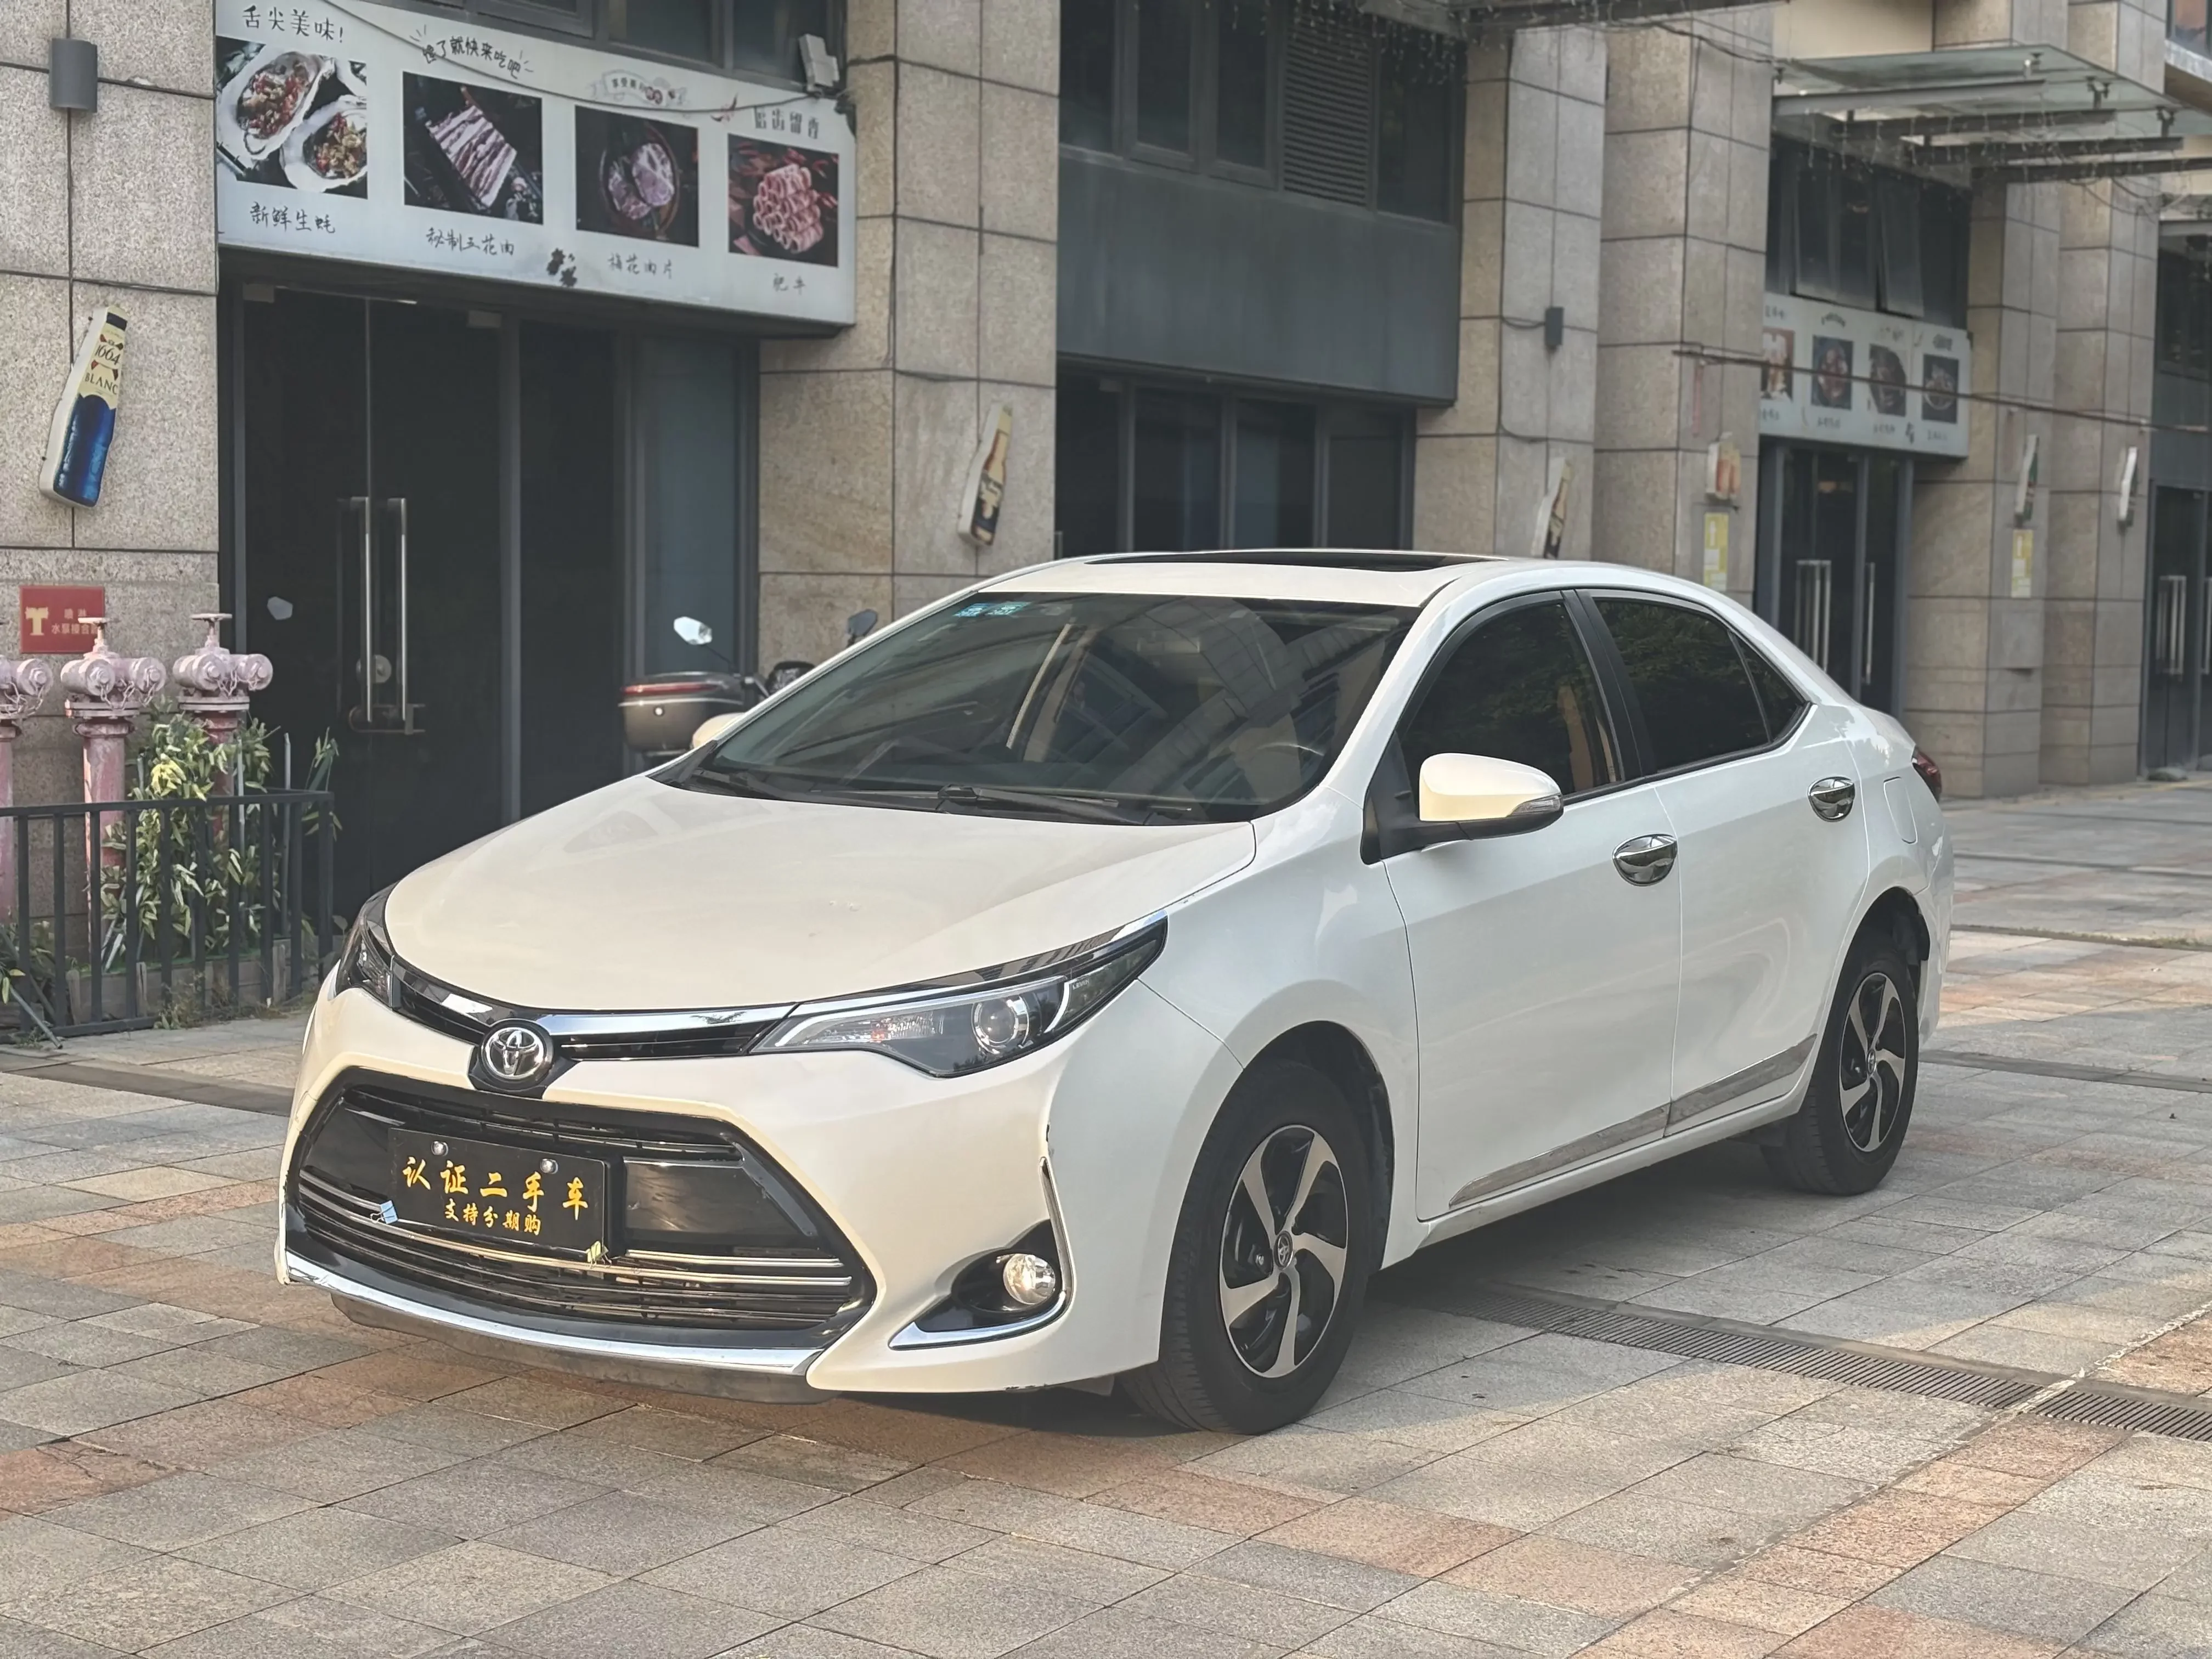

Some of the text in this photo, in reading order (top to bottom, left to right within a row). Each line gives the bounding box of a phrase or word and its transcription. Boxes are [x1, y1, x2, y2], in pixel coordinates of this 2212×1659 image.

[242, 5, 343, 43] 舌尖美味!
[250, 201, 336, 234] 新鲜生蚝
[426, 226, 515, 256] 秘制五花肉
[607, 252, 672, 280] 梅花肉片
[772, 272, 805, 296] 肥牛
[94, 344, 121, 365] 1664
[84, 373, 118, 394] BLANC
[402, 1156, 588, 1221] 认证二手车
[444, 1198, 541, 1235] 支持分期购
